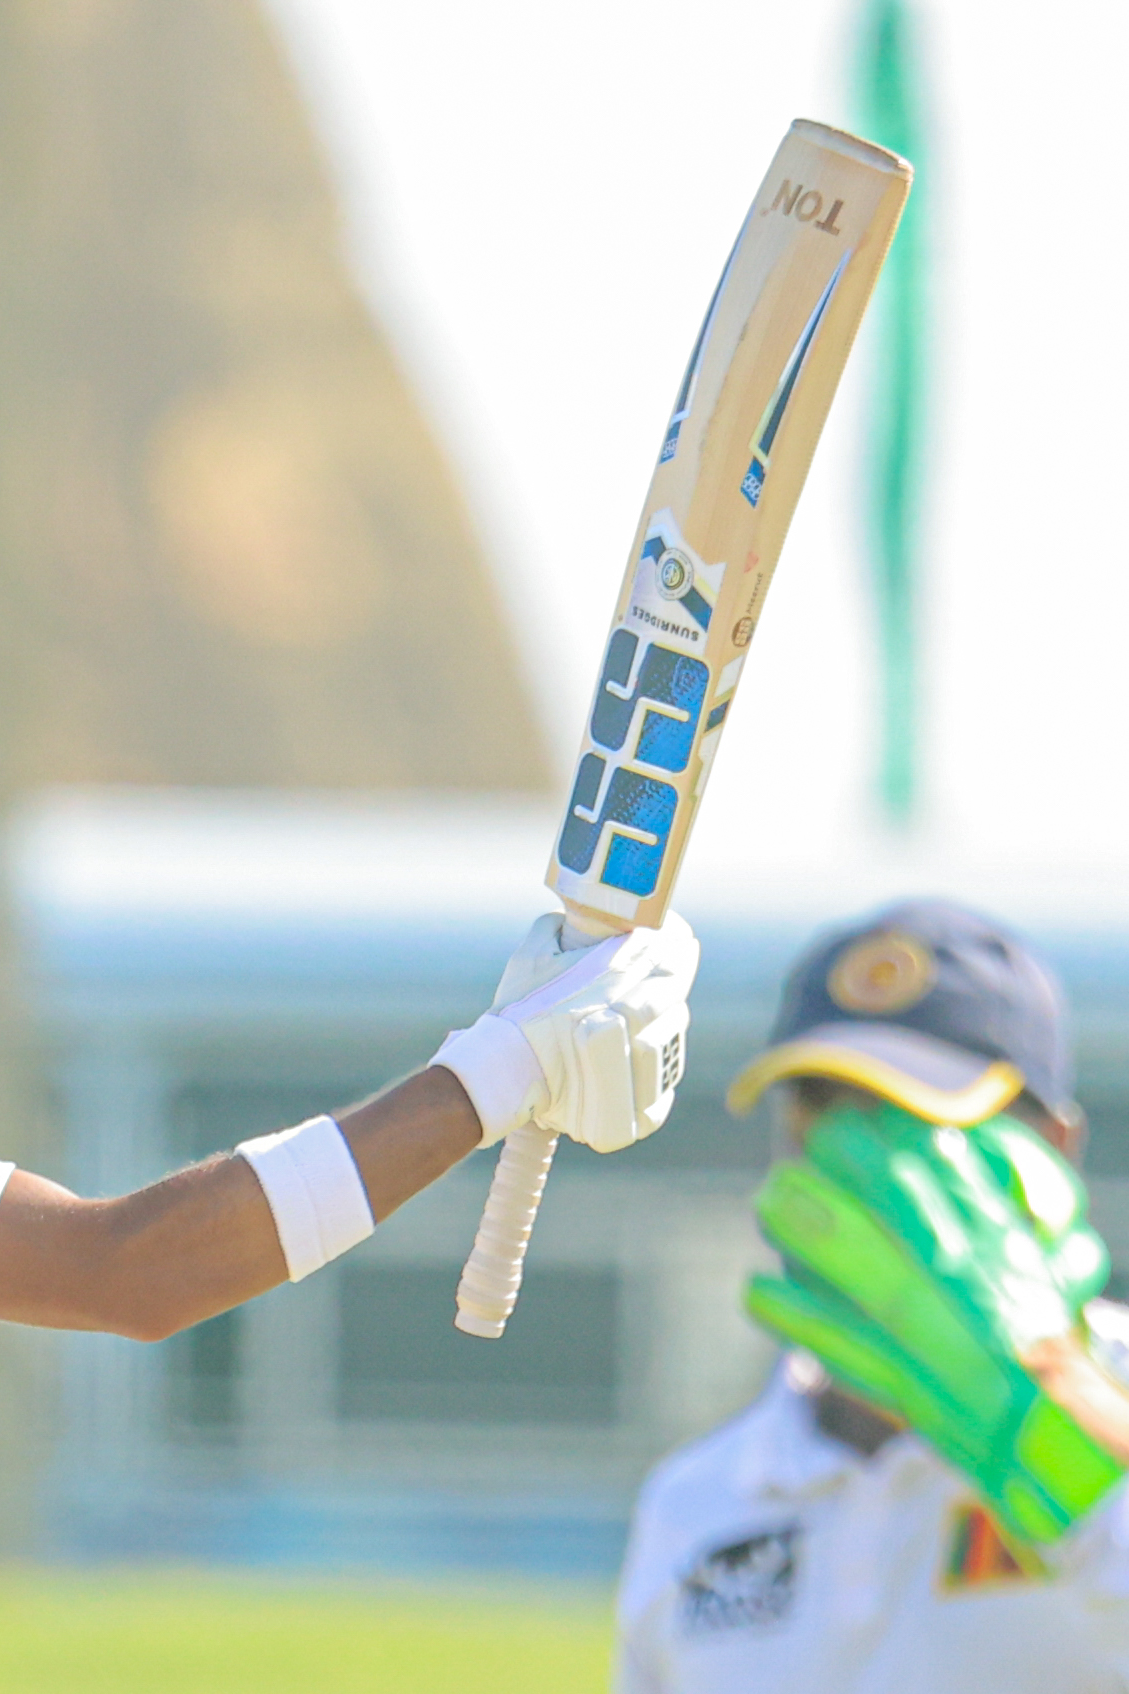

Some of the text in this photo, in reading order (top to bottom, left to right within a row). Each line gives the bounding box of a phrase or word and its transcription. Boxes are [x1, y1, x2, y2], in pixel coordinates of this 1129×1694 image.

[771, 179, 844, 236] TON
[632, 605, 699, 642] SUNRIDGES
[556, 626, 710, 898] SS
